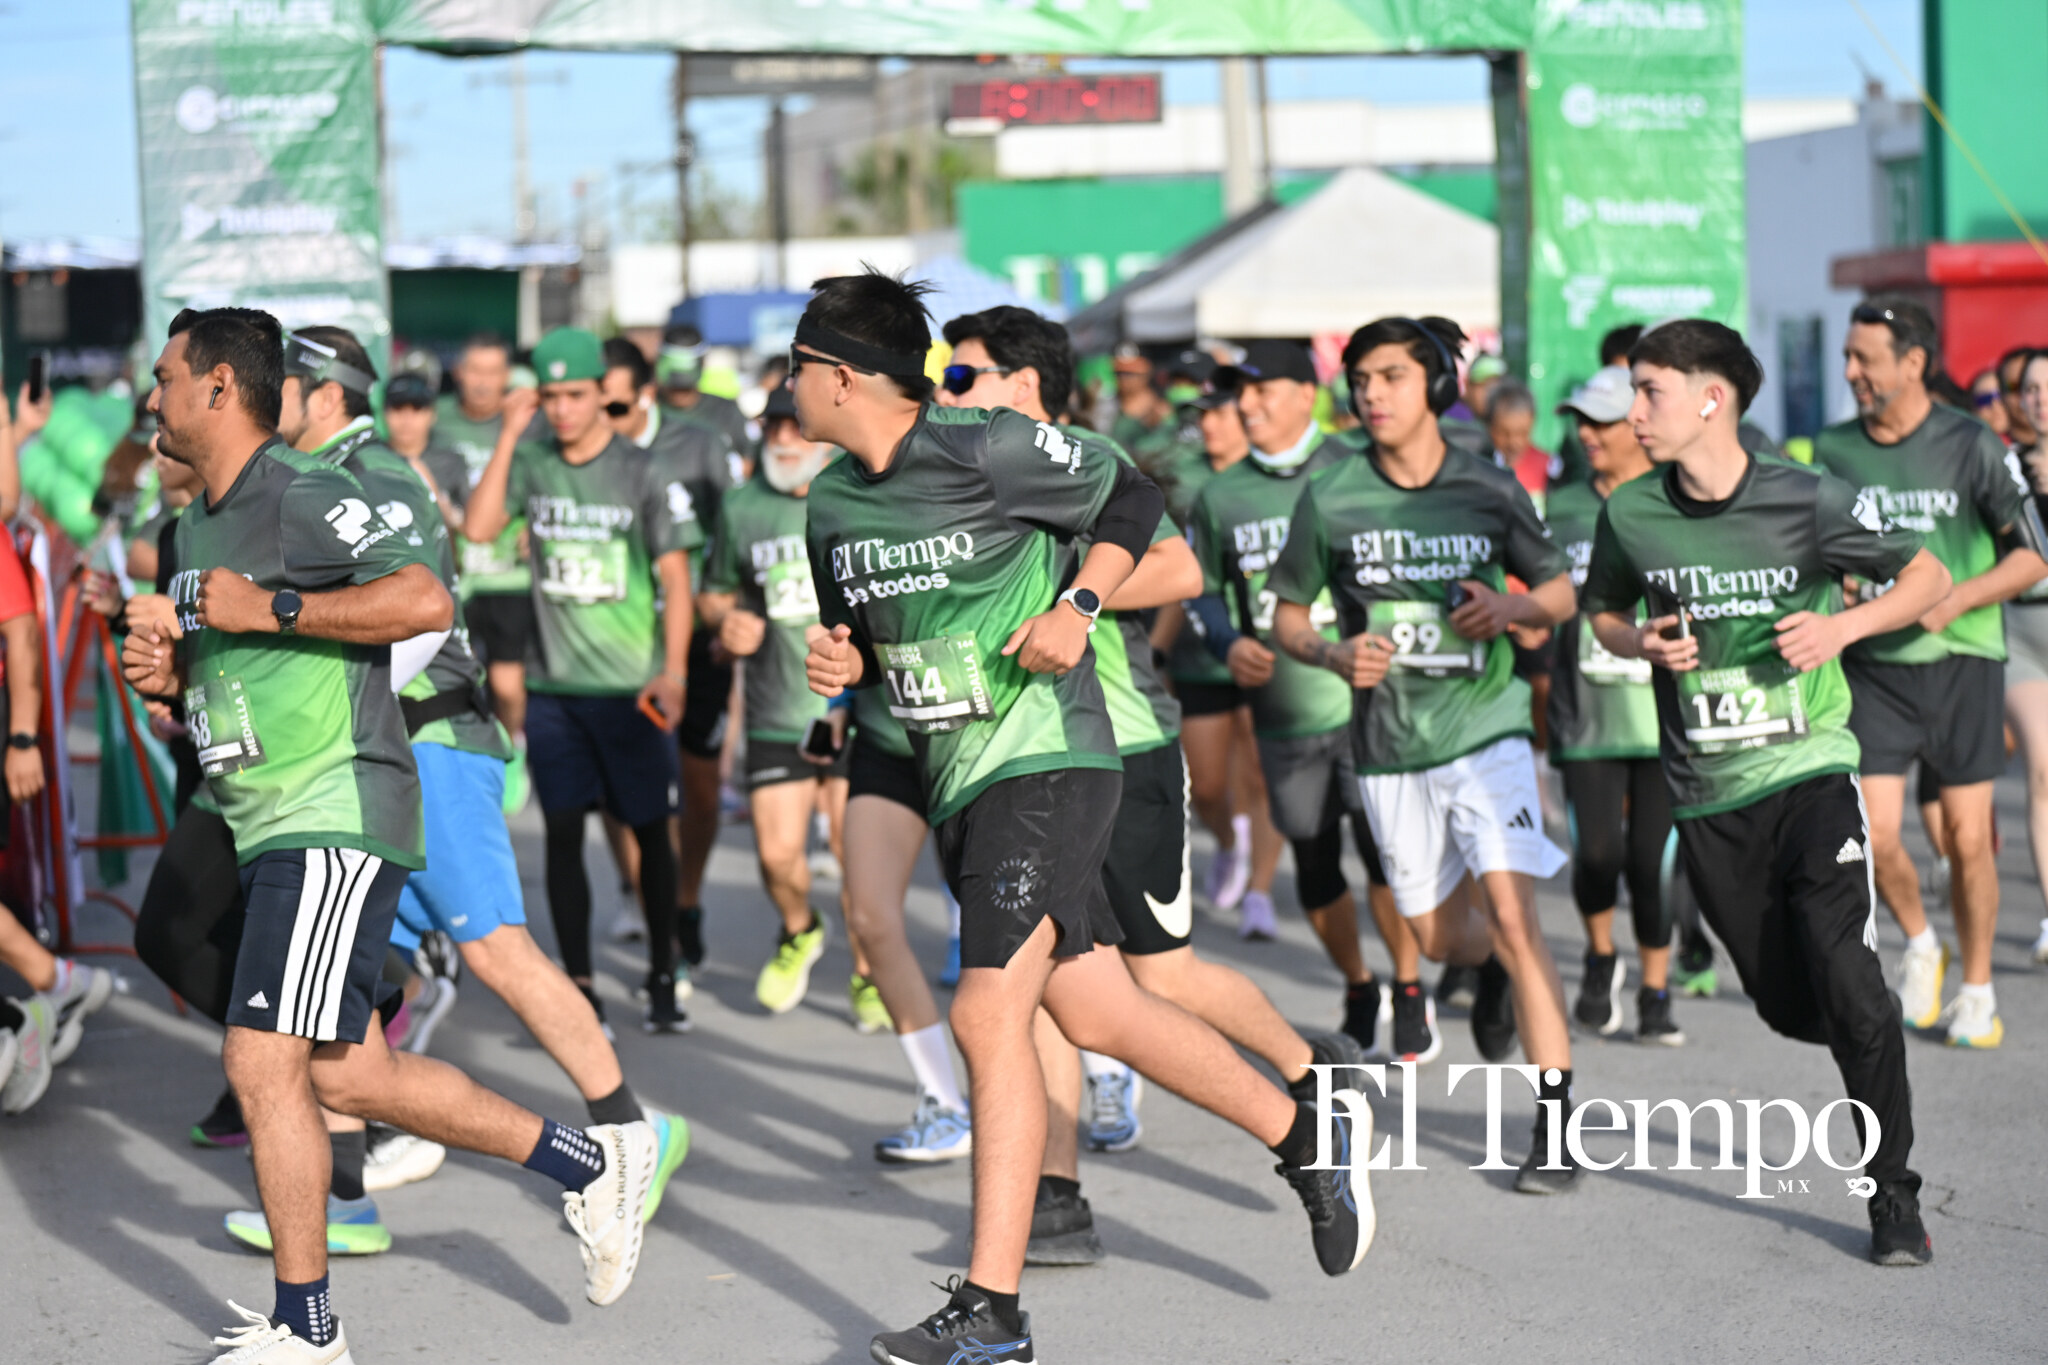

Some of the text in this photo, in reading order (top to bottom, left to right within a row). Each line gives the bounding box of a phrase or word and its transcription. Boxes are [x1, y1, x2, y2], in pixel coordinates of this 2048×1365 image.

[831, 541, 856, 583] El
[854, 531, 974, 575] Tiempo
[1351, 529, 1492, 564] El Tiempo
[868, 571, 950, 599] todos
[1355, 561, 1472, 586] de todos
[1679, 565, 1799, 598] Tiempo
[1689, 597, 1776, 621] todos
[1391, 621, 1442, 655] 99
[887, 666, 947, 706] 144
[963, 654, 989, 715] MEDALLA
[235, 695, 260, 757] MEDALLA
[1692, 688, 1770, 728] 142
[612, 1128, 627, 1220] ON RUNNING
